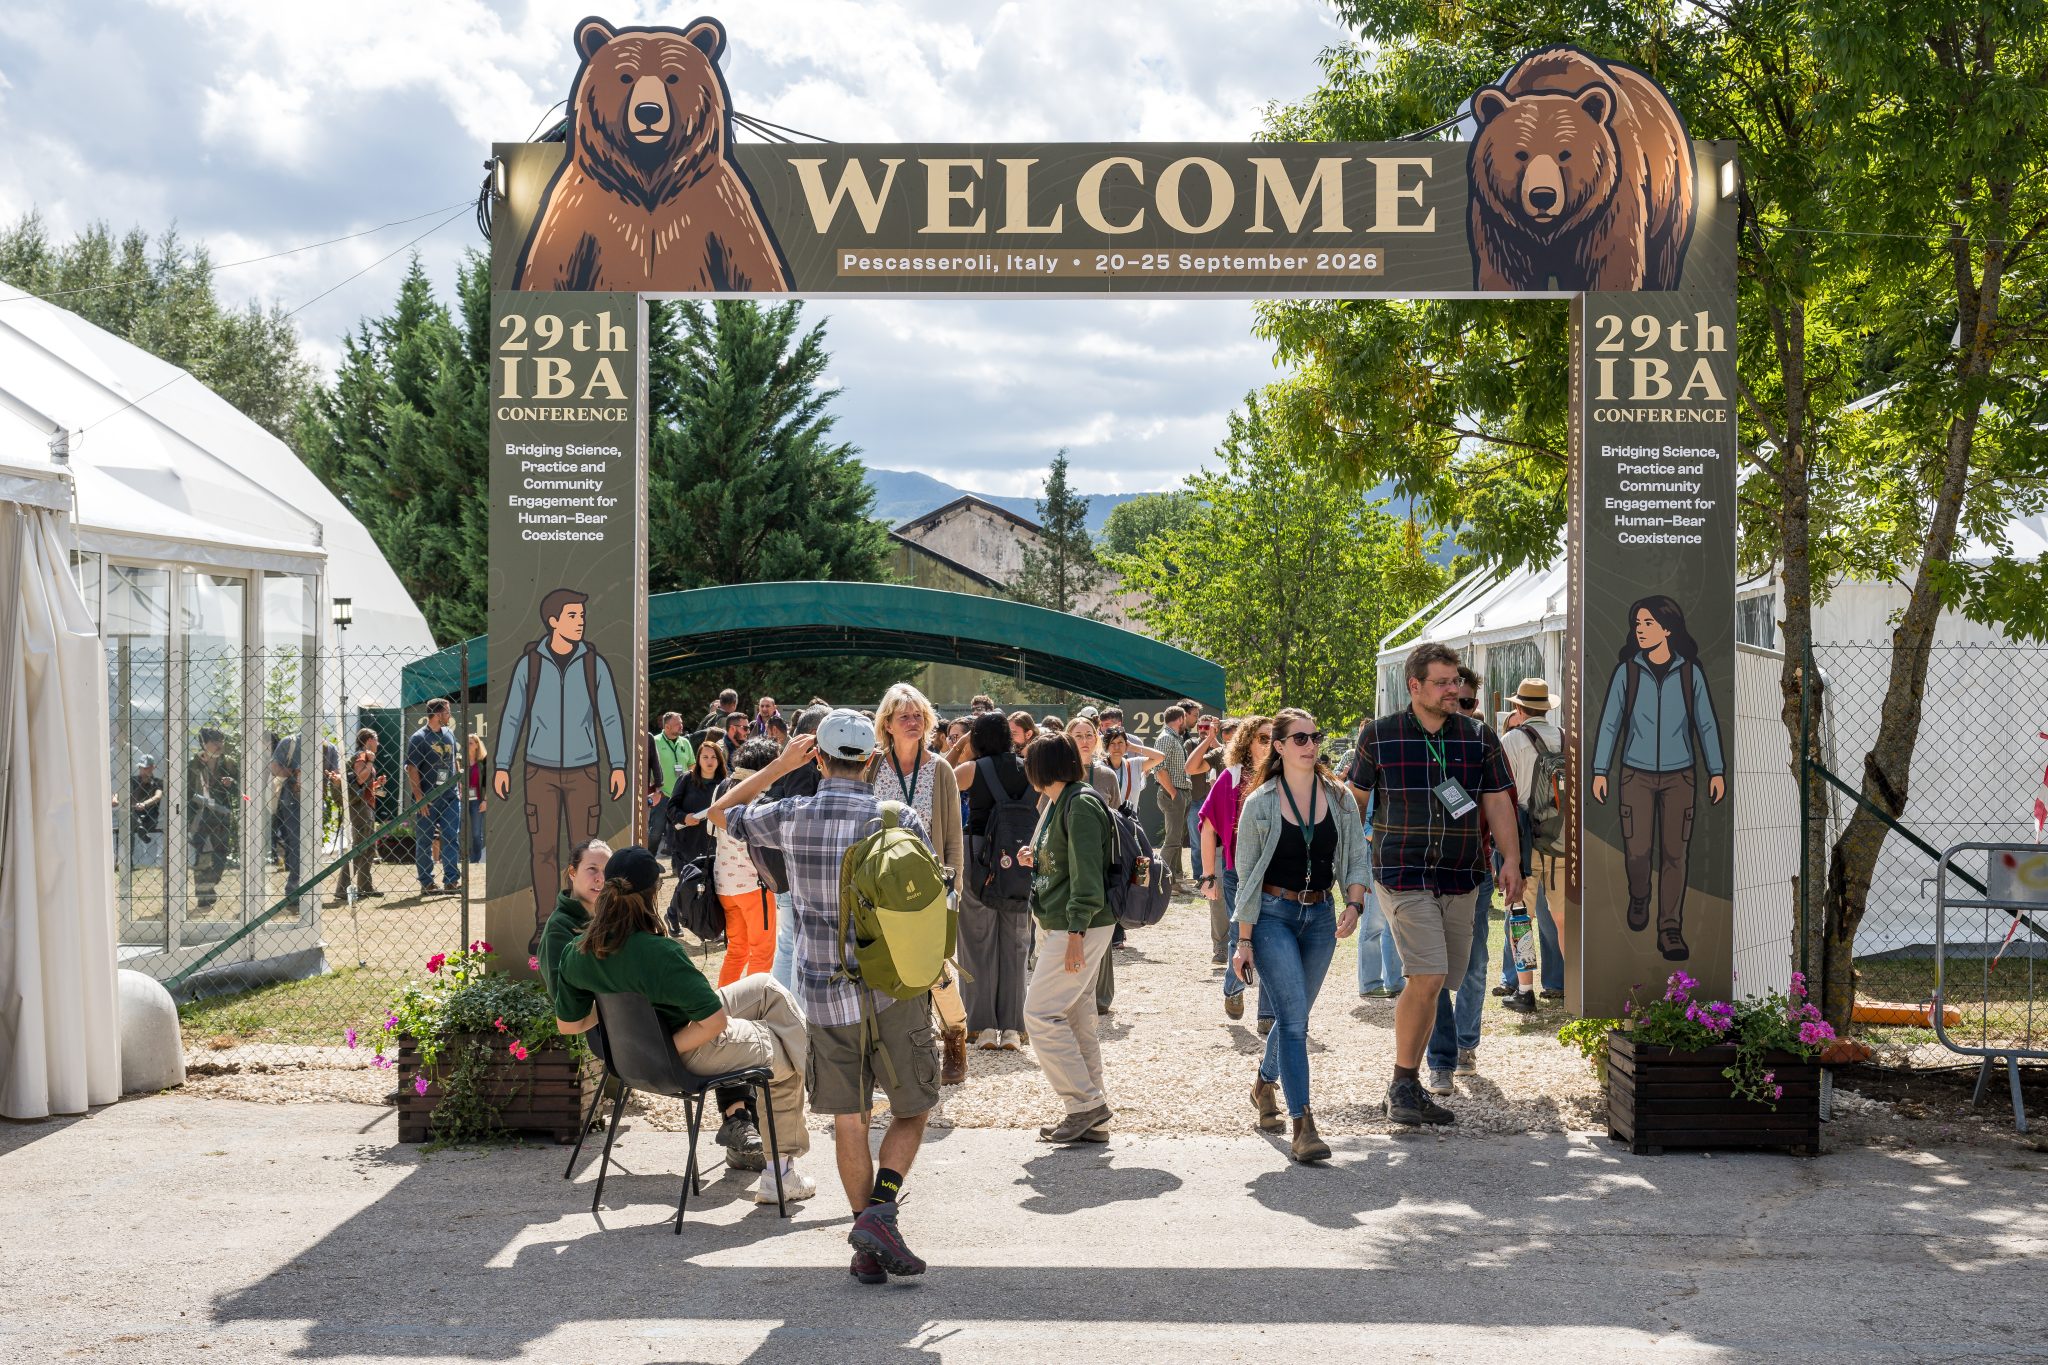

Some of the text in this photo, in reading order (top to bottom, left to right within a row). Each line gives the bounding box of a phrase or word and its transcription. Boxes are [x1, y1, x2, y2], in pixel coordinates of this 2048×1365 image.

[787, 156, 1436, 235] WELCOME
[844, 254, 999, 274] Pescasseroli,
[1007, 254, 1059, 275] Italy
[1178, 253, 1308, 274] September
[1316, 253, 1377, 270] 2026
[499, 311, 629, 352] 29th
[1595, 310, 1728, 352] 29th
[498, 356, 628, 400] IBA
[1594, 357, 1727, 401] IBA
[497, 407, 628, 422] CONFERENCE
[1593, 408, 1727, 423] CONFERENCE
[505, 443, 622, 459] Bridging Science,
[1601, 445, 1720, 461] Bridging Science,
[521, 460, 606, 473] Practice and
[1572, 411, 1580, 532] alongside
[1617, 462, 1704, 475] Practice and
[523, 477, 604, 492] Community
[1619, 479, 1701, 495] Community
[508, 494, 618, 509] Engagement for
[1605, 497, 1716, 512] Engagement for
[521, 529, 605, 541] Coexistence
[1618, 531, 1702, 544] Coexistence
[1570, 659, 1578, 739] global
[1569, 744, 1578, 887] perspective
